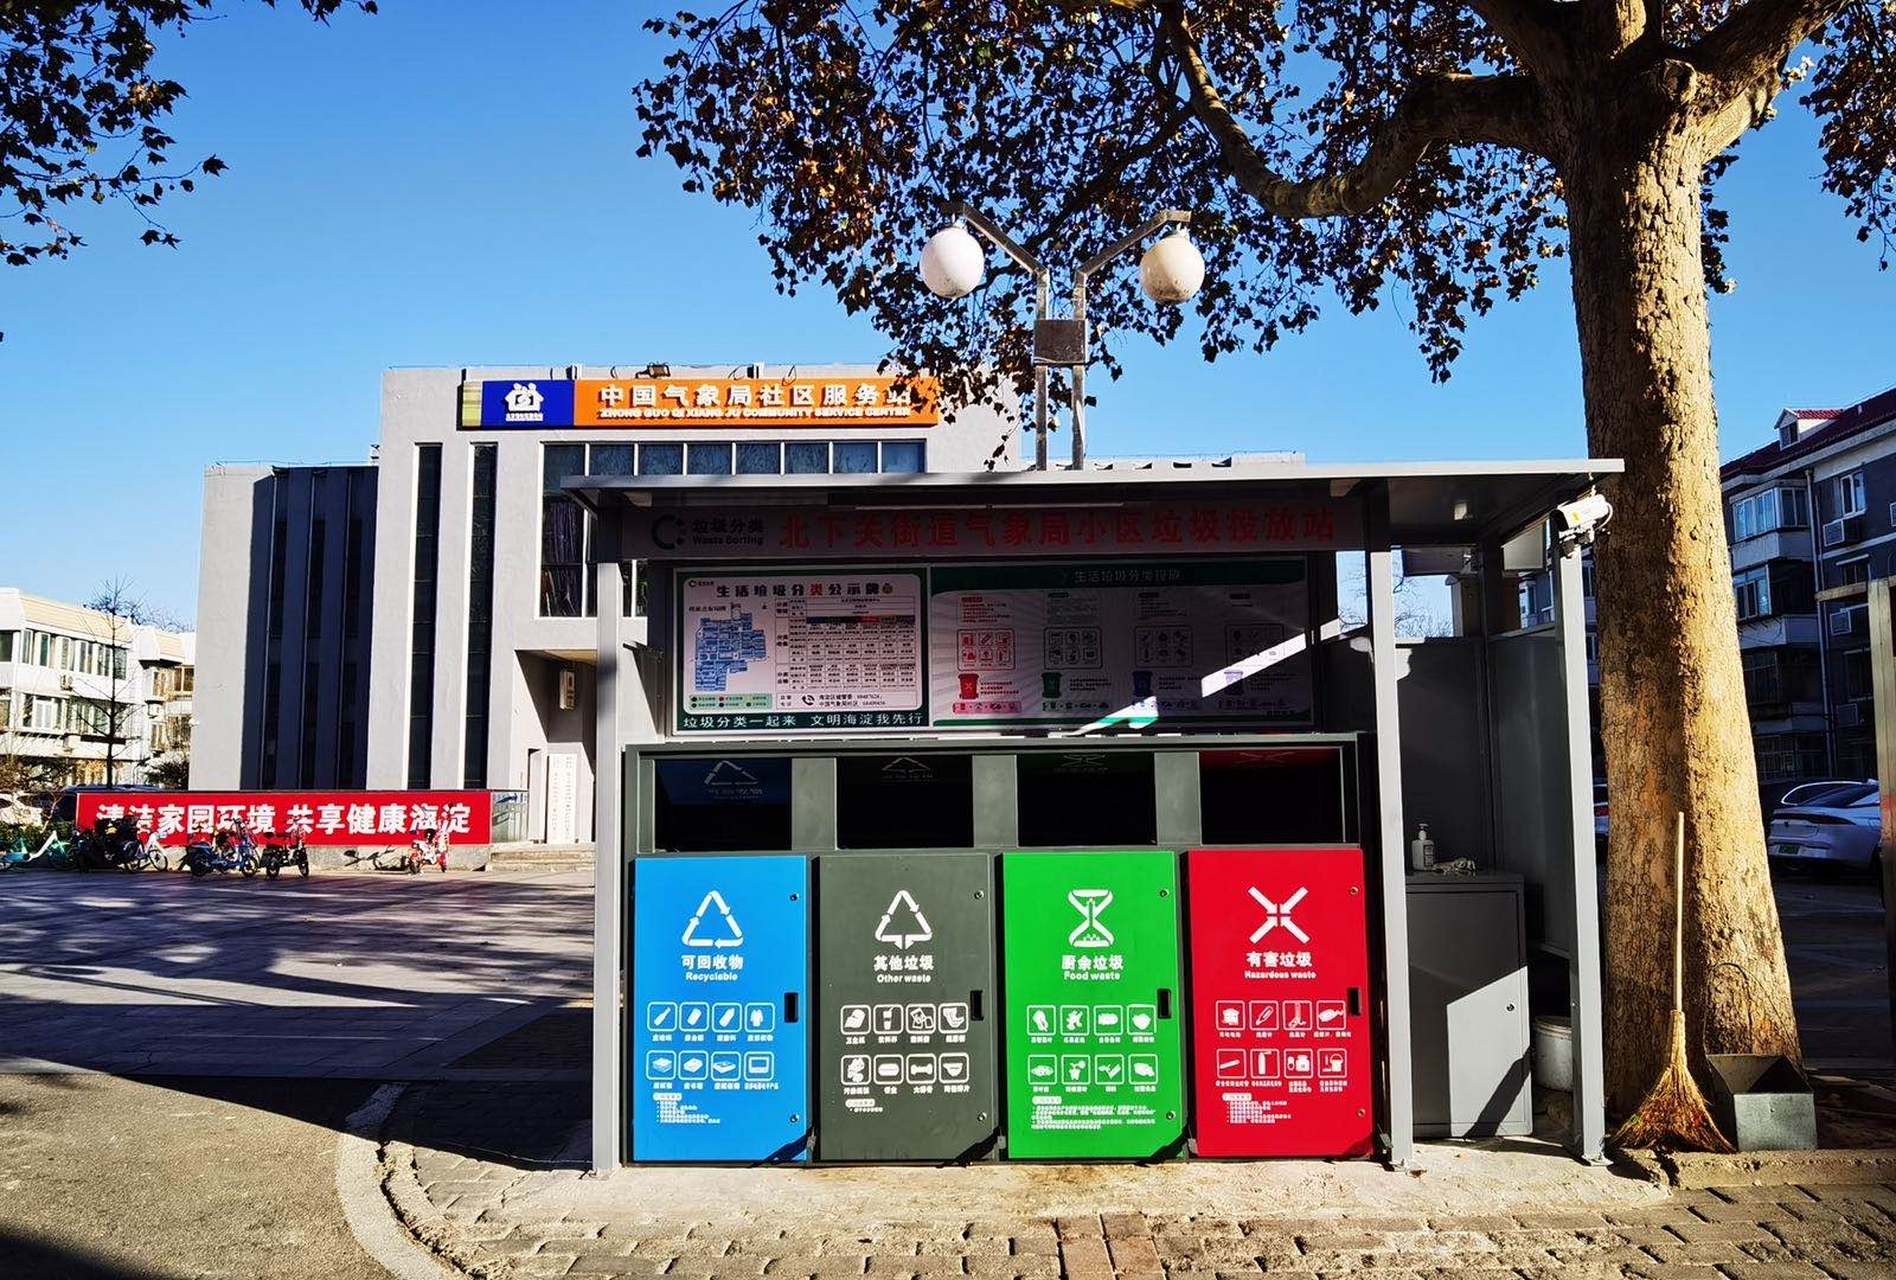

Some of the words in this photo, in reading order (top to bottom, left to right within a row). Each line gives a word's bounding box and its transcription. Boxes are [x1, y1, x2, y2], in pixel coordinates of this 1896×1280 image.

[601, 409, 641, 418] ZHONG
[644, 409, 669, 418] GUO
[672, 409, 684, 418] QI
[686, 409, 723, 418] XIANG
[726, 408, 740, 417] JU
[743, 408, 814, 417] COMMUNITY
[815, 408, 862, 417] SERVICE
[865, 407, 911, 417] CENTER
[692, 518, 764, 534] 垃圾分类
[693, 534, 723, 545] Waste
[726, 534, 764, 546] Sorting
[716, 582, 880, 598] 生活垃圾分类公示牌
[683, 715, 797, 729] 垃圾分类一起来
[810, 712, 923, 727] 文明海淀我先行
[286, 803, 471, 834] 共享健康海淀
[681, 954, 744, 970] 可回收物
[873, 954, 935, 971] 其他垃圾
[1061, 955, 1124, 970] 厨余垃圾
[1246, 951, 1313, 968] 有害垃圾
[686, 972, 738, 982] Recyclable
[876, 974, 903, 983] Other
[904, 974, 932, 983] waste
[1064, 971, 1089, 980] Food
[1091, 972, 1120, 980] waste
[1244, 970, 1289, 979] Hazardous
